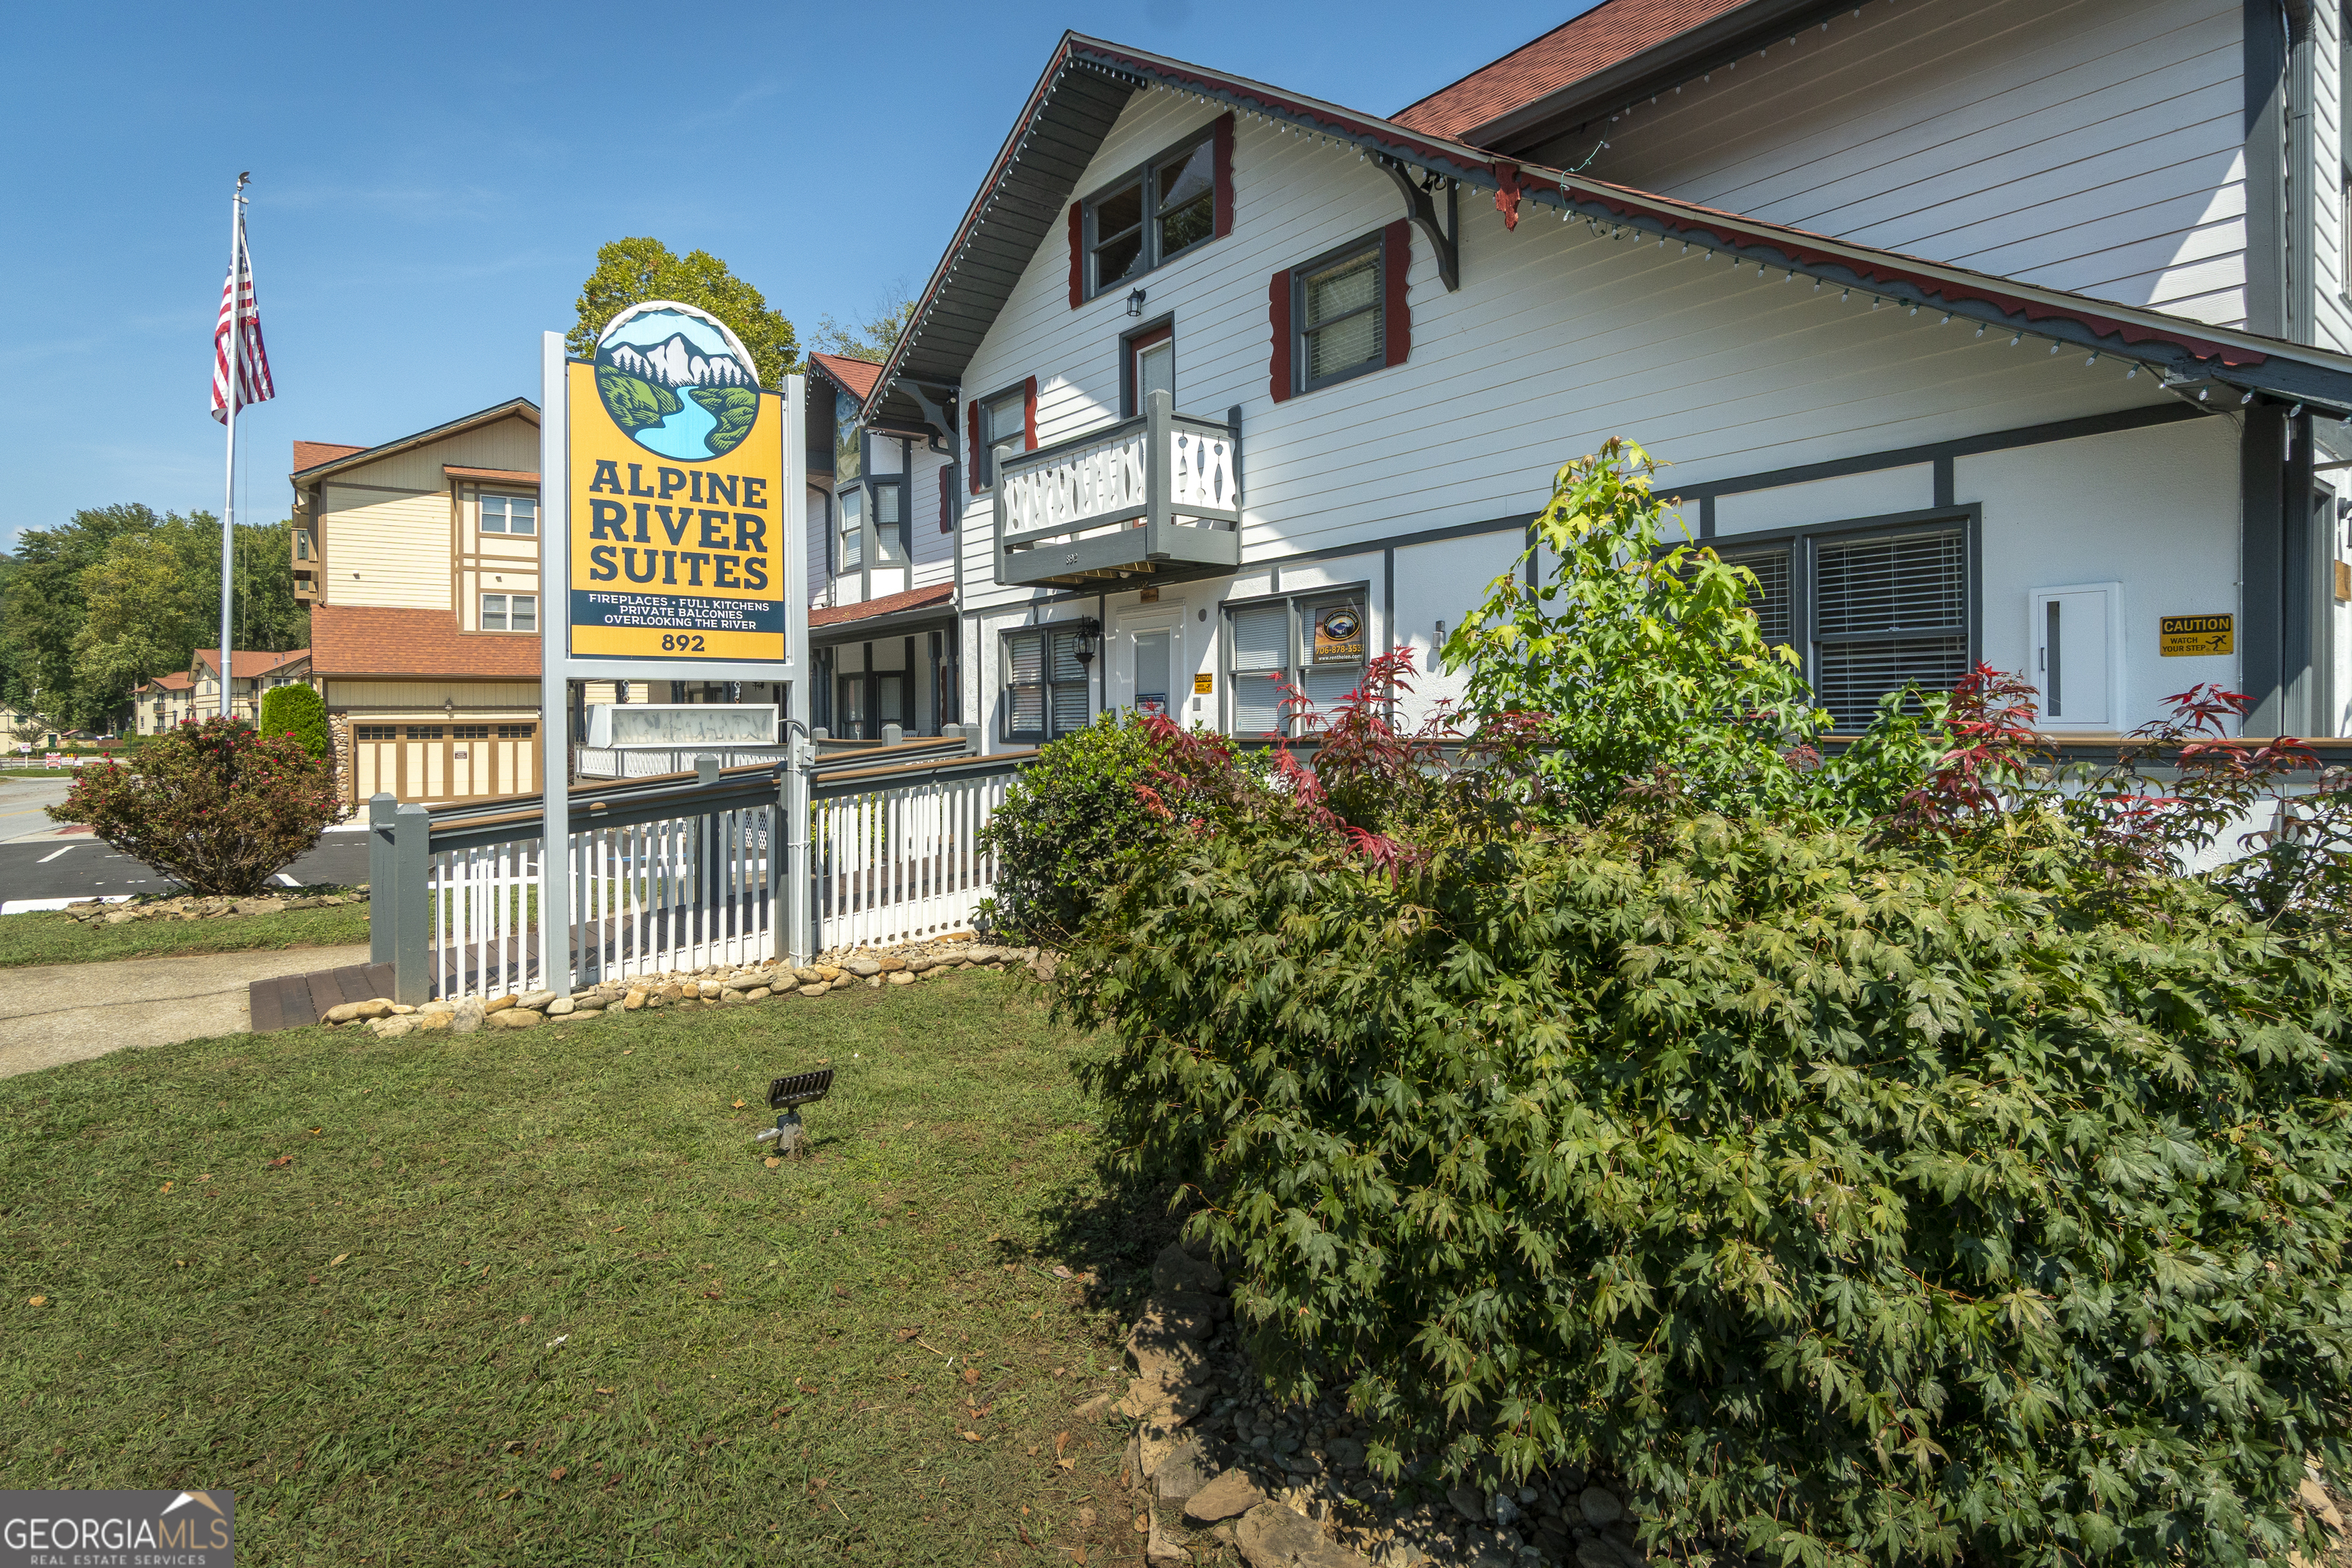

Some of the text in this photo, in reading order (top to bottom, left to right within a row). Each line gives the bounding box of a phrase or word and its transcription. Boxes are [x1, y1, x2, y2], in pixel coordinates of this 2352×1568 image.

[589, 459, 768, 510] ALPINE
[589, 498, 768, 553] RIVER
[590, 544, 769, 590] SUITES
[589, 593, 769, 611] FIREPLACES FULL KITCHENS
[619, 605, 743, 619] PRIVATE BALCONIES
[604, 615, 756, 629] OVERLOOKING THE RIVER
[2164, 618, 2230, 632] CAUTION
[662, 634, 705, 652] 892
